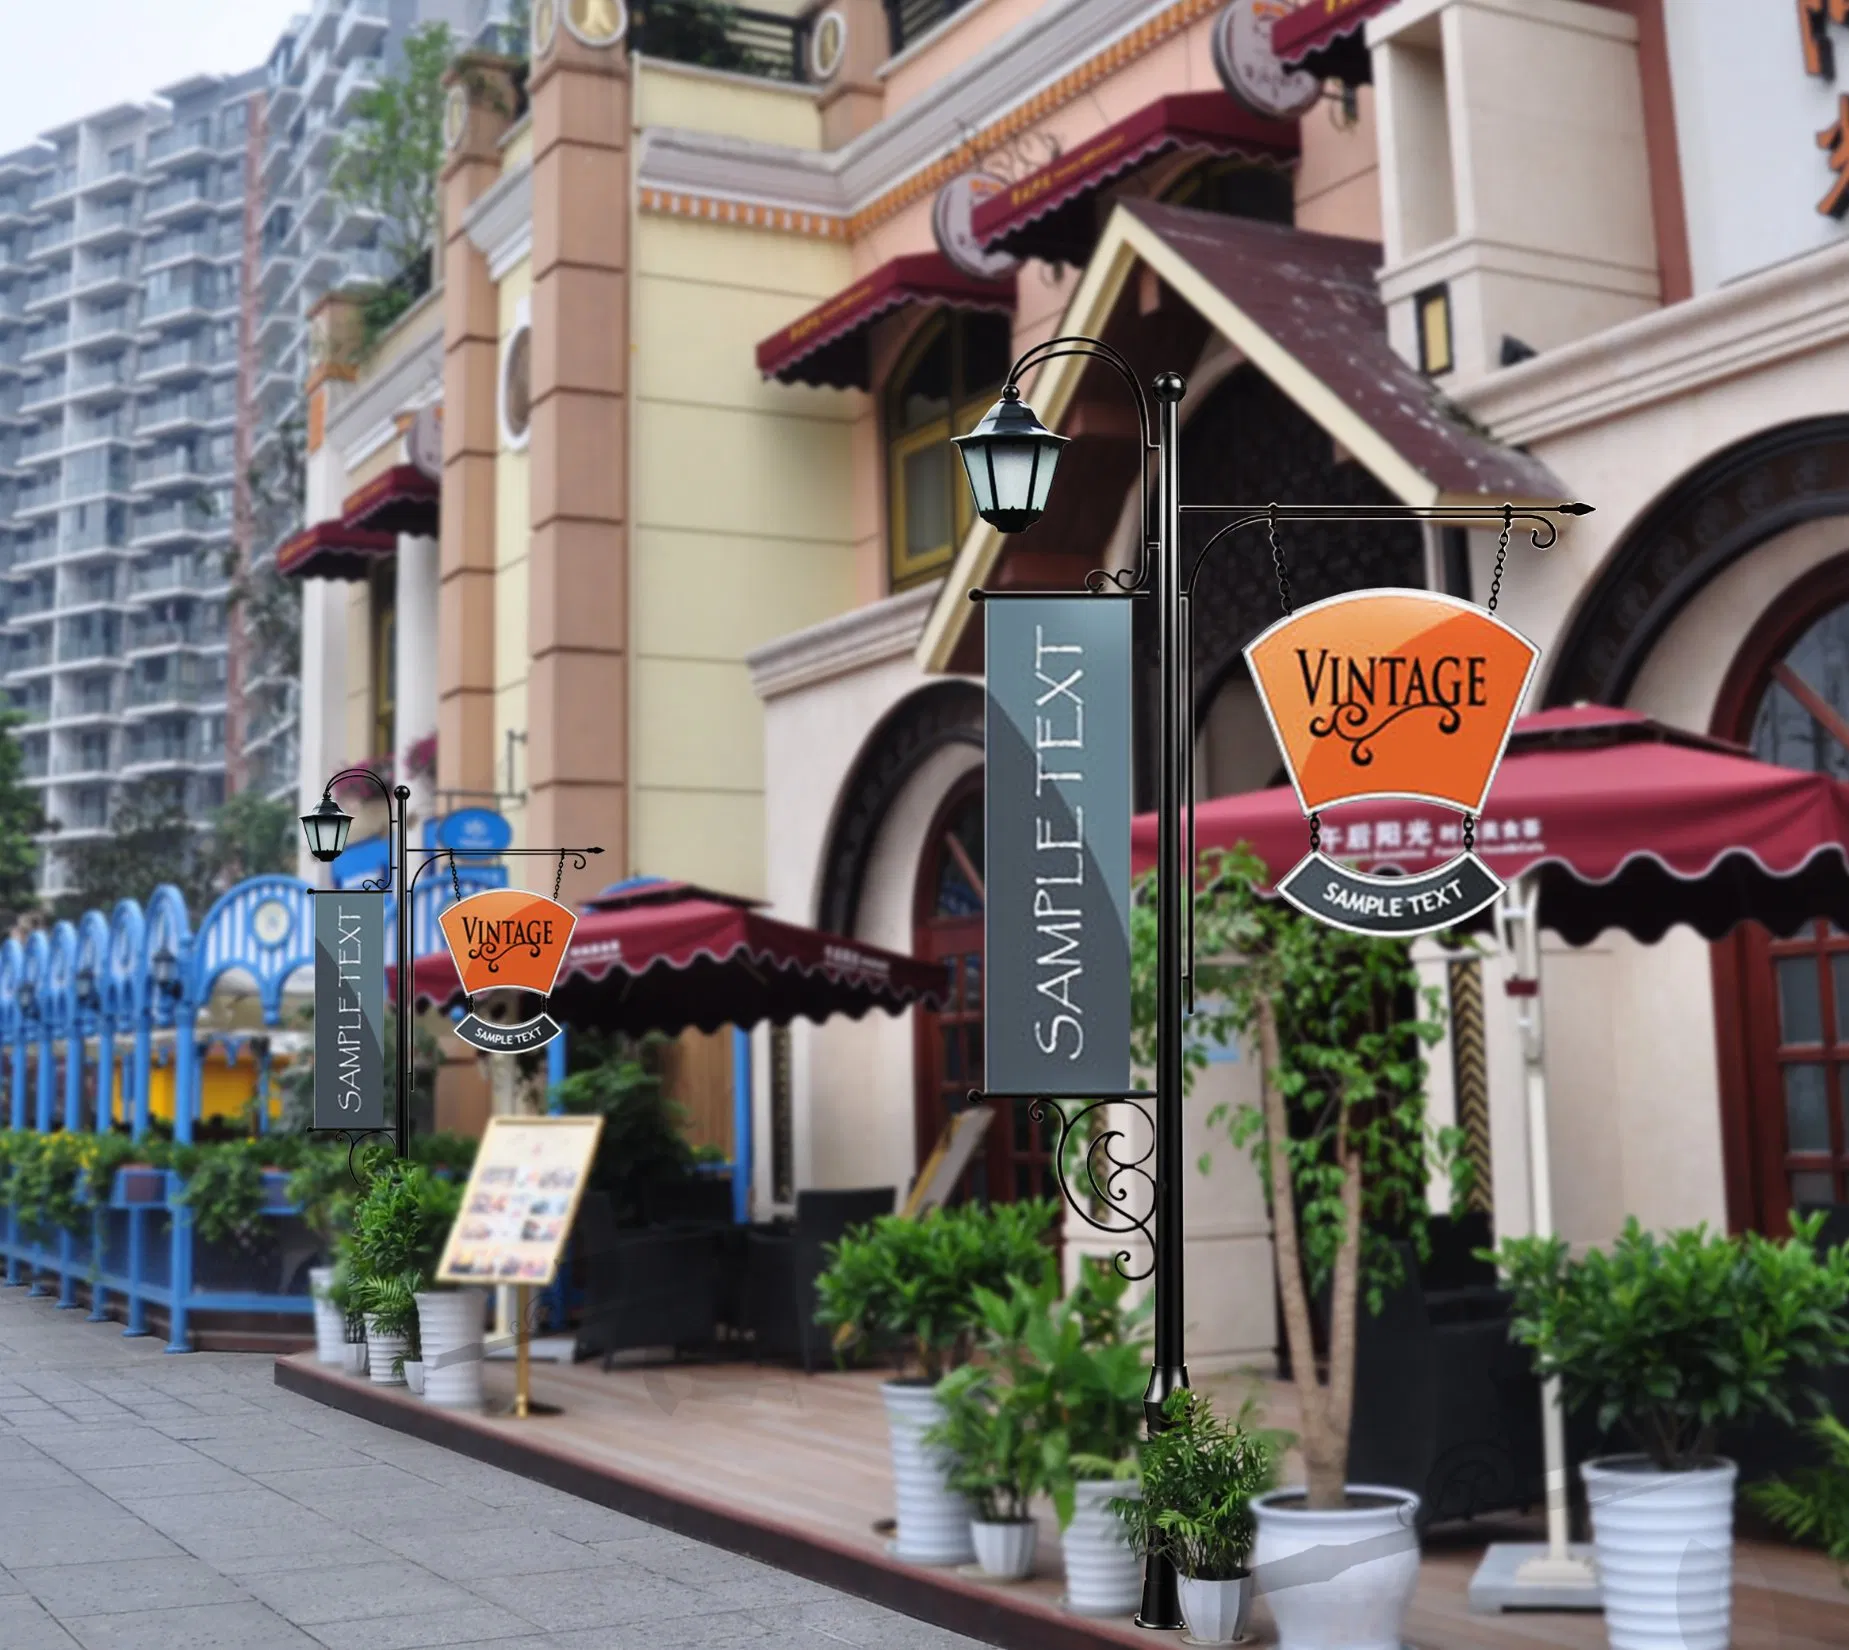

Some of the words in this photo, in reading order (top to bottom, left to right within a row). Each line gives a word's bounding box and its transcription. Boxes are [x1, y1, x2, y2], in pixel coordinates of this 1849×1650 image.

[1033, 624, 1085, 797] TEXT
[337, 905, 362, 988] TEXT
[1033, 806, 1085, 1061] SAMPLE
[1322, 881, 1403, 917] SAMPLE
[1406, 879, 1463, 915] TEXT
[337, 991, 362, 1113] SAMPLE
[474, 1027, 514, 1045] SAMPLE
[514, 1026, 543, 1043] TEXT
